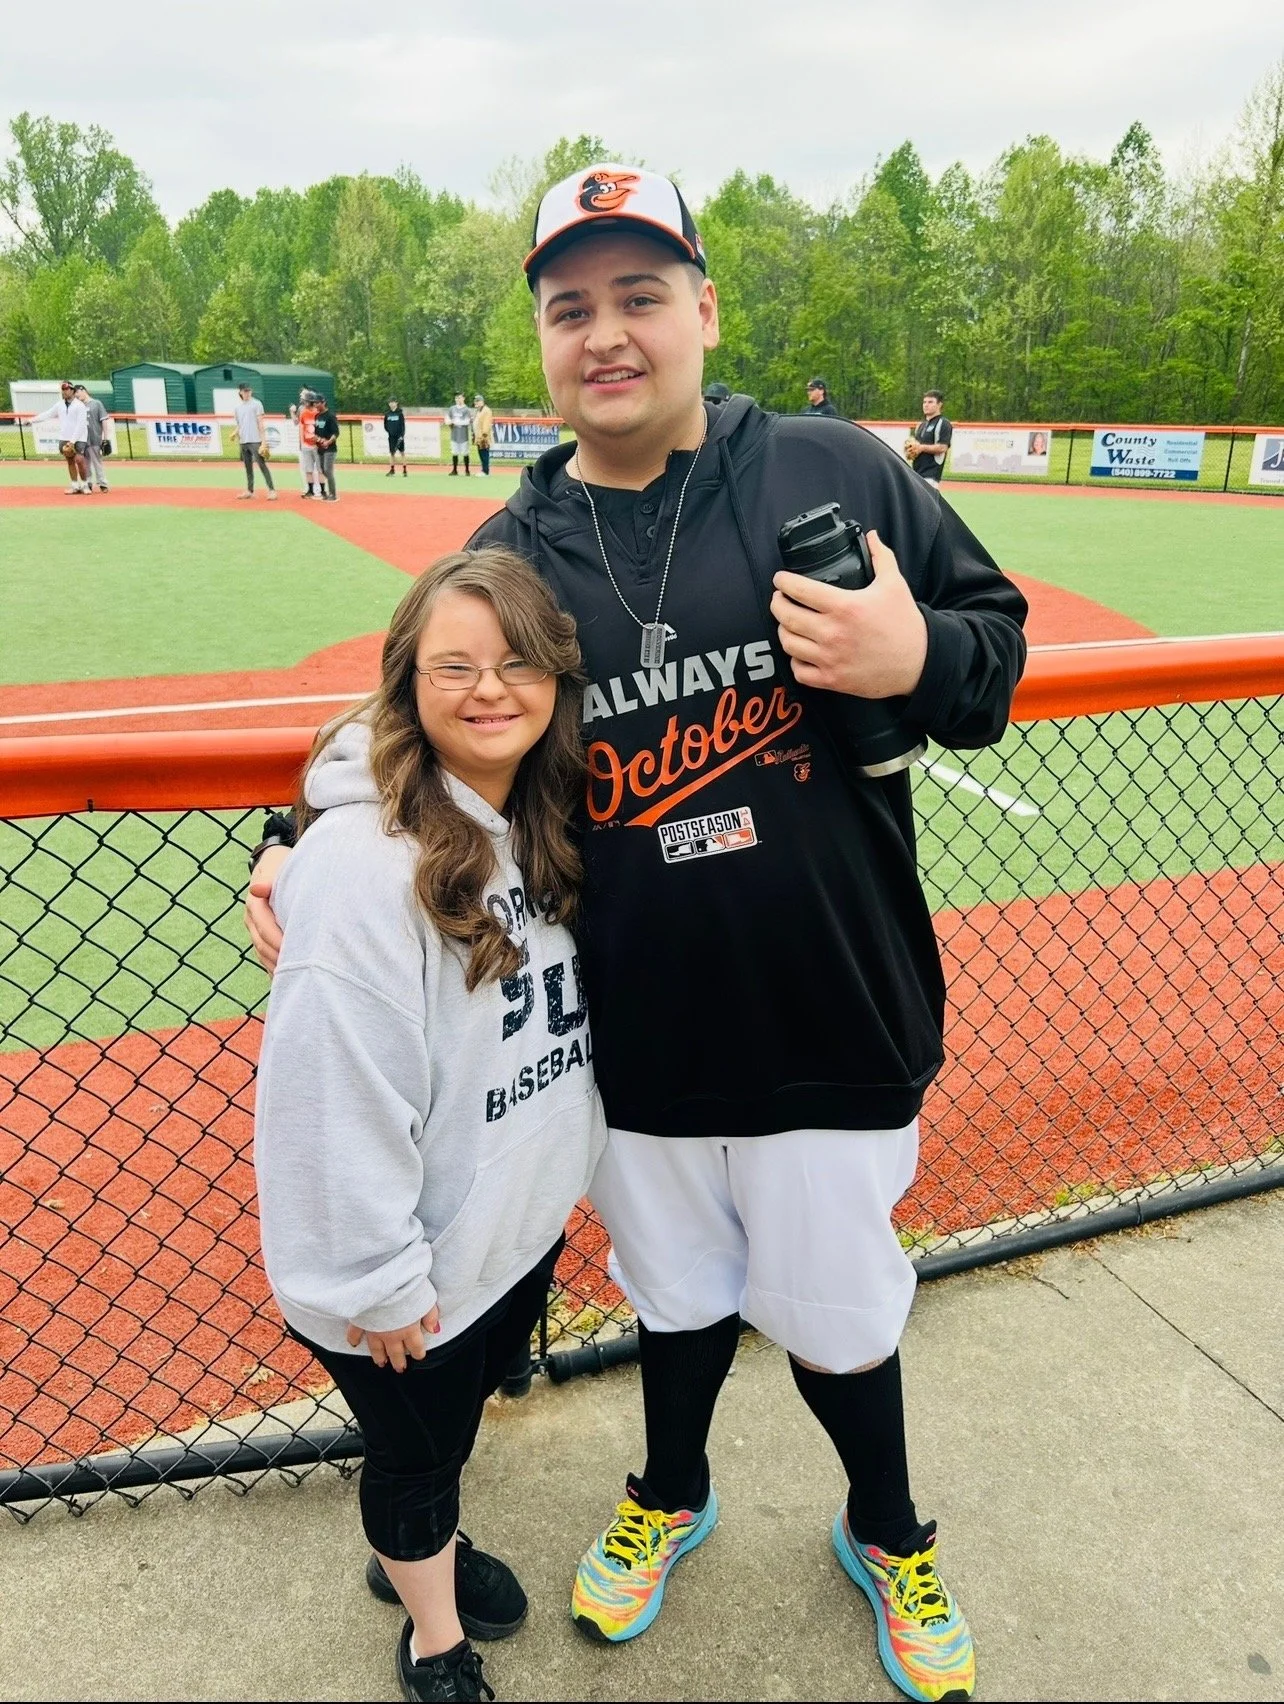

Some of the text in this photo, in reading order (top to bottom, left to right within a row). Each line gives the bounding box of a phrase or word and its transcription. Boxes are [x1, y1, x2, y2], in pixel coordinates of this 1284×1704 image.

[155, 422, 211, 435] Little
[495, 423, 520, 442] WIS
[157, 435, 177, 443] TIRE
[1101, 433, 1157, 447] County
[1107, 448, 1156, 466] Waste
[583, 639, 776, 723] ALWAYS
[587, 687, 802, 822] October
[660, 810, 742, 844] POSTSEASON
[486, 1031, 594, 1123] BASEBAL
